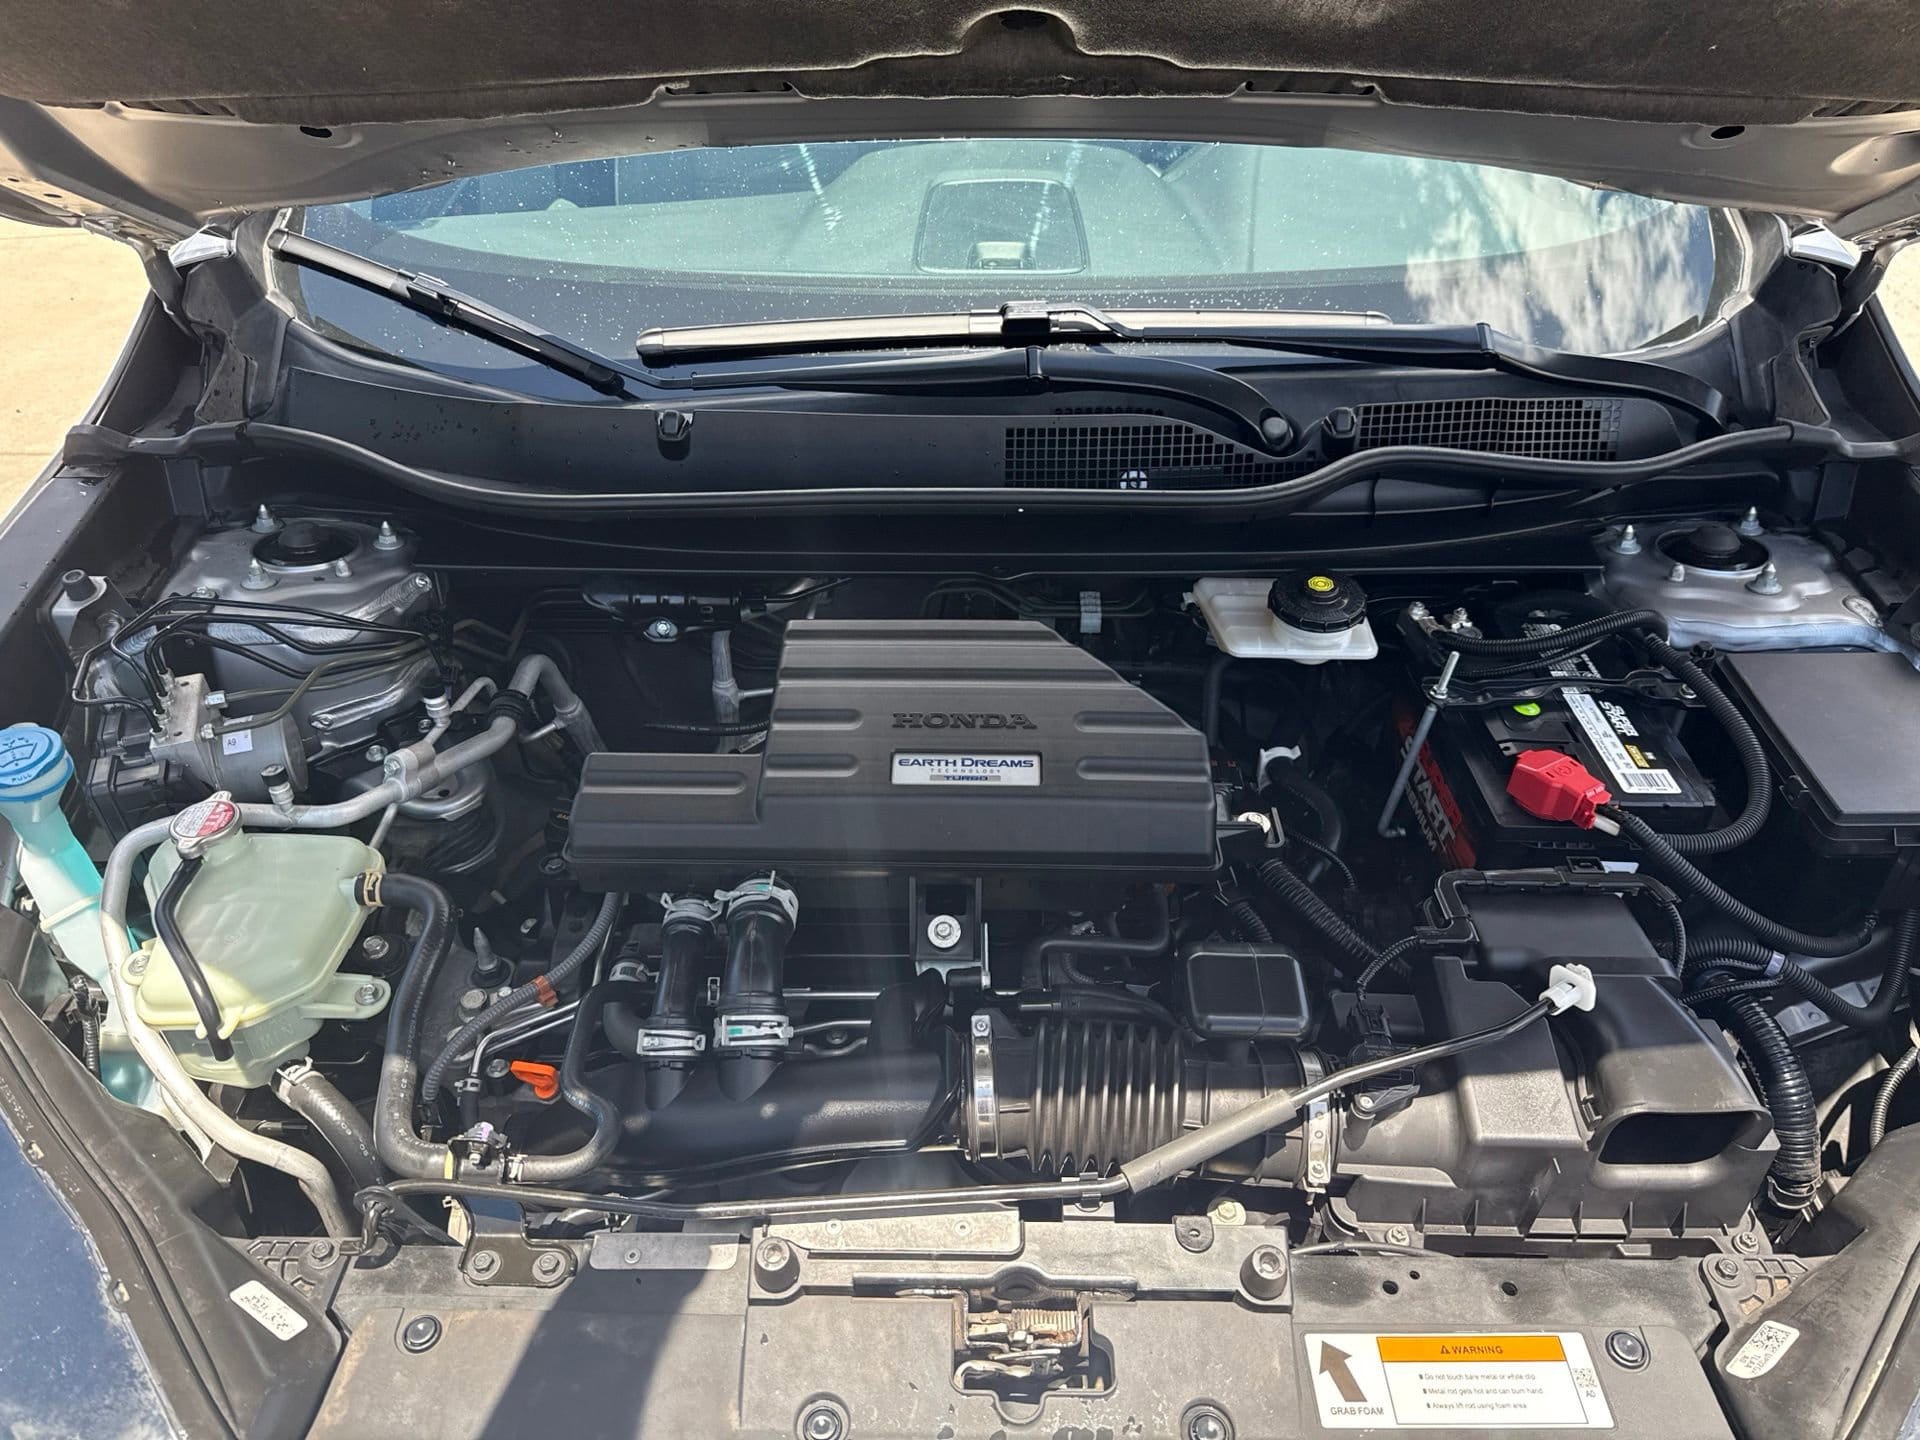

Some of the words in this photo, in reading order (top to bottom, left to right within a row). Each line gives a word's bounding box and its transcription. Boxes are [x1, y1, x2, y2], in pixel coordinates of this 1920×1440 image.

[892, 712, 1038, 729] HONDA
[898, 759, 957, 767] EARTH
[961, 757, 1034, 768] DREAMS
[11, 773, 32, 783] PULL
[1451, 1345, 1504, 1354] WARNING
[1459, 1388, 1473, 1396] gets
[1330, 1406, 1357, 1415] GRAB
[1358, 1406, 1384, 1415] FOAM
[1432, 1402, 1455, 1410] Always
[1477, 1402, 1494, 1410] using
